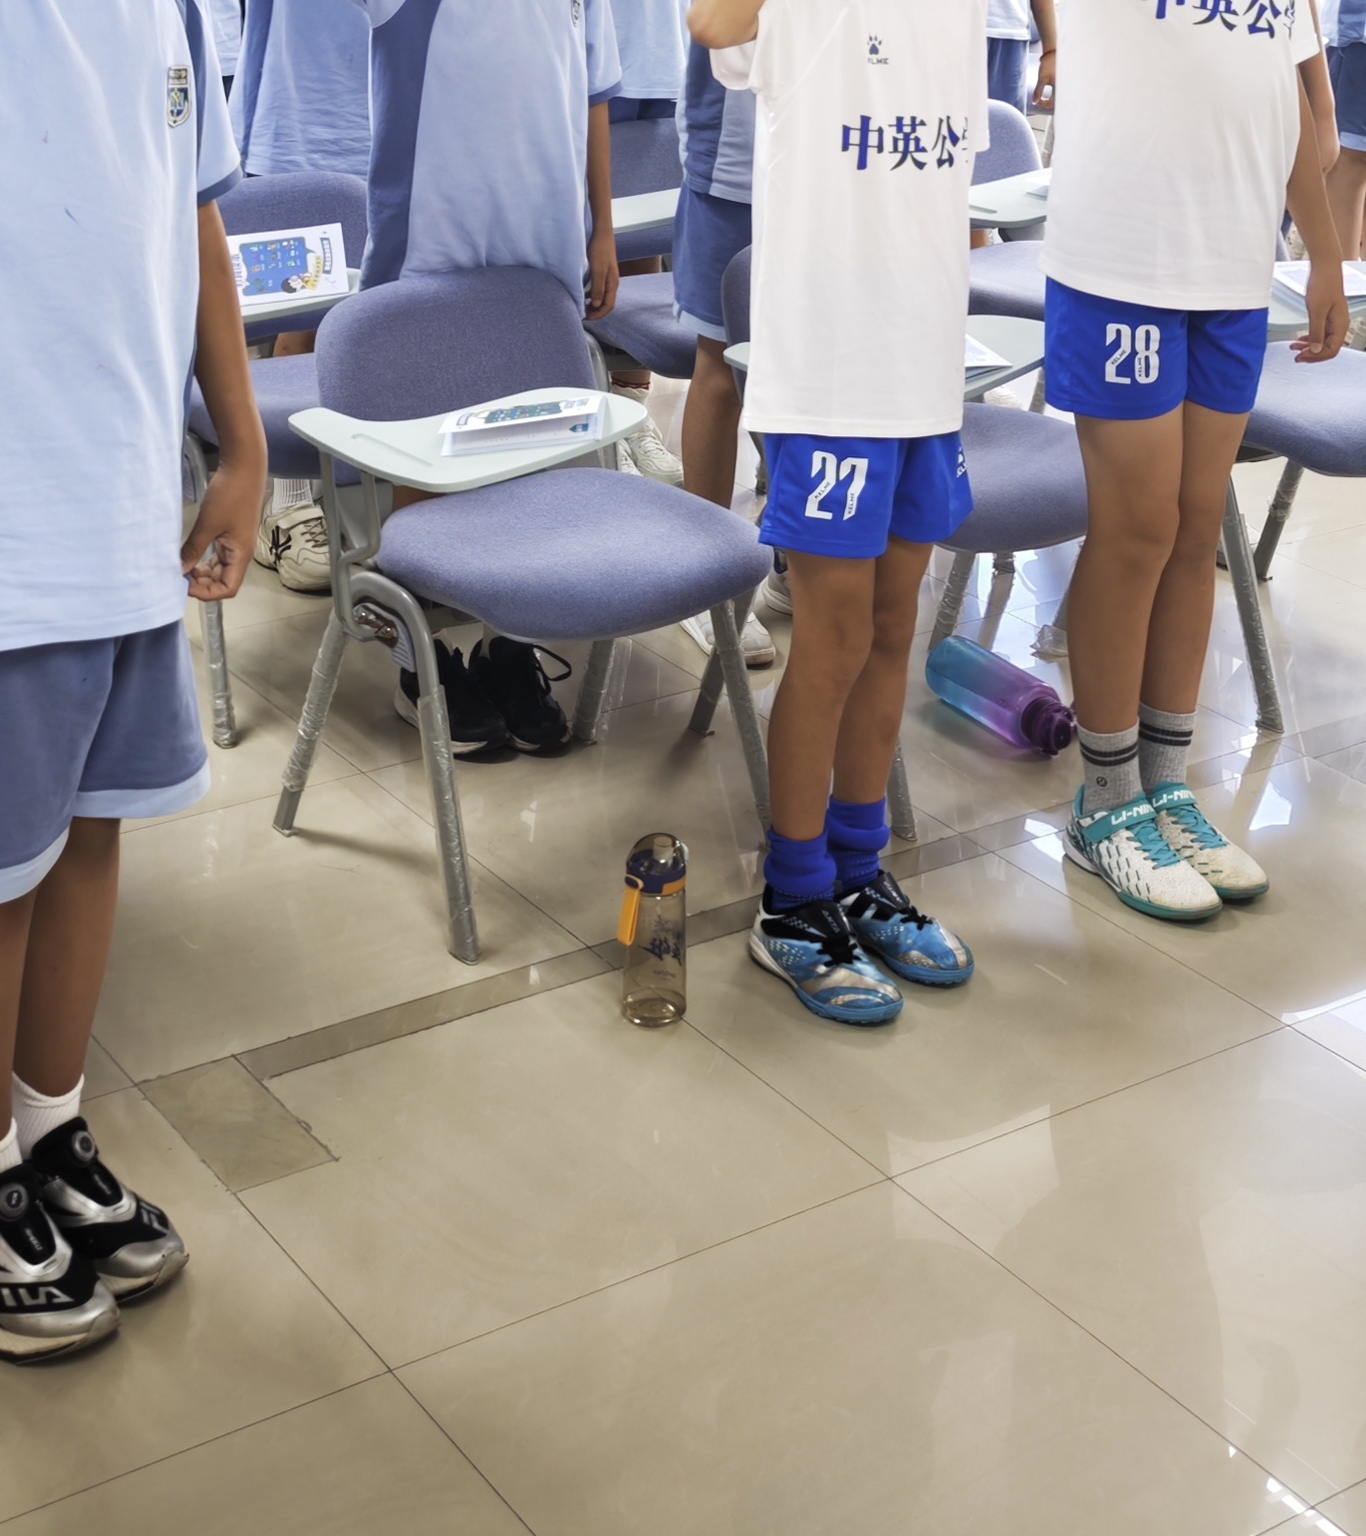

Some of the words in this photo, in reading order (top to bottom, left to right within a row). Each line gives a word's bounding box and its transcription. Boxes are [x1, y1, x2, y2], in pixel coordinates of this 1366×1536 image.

[841, 114, 969, 172] 中英公
[1105, 322, 1161, 385] 28
[804, 449, 869, 521] 27
